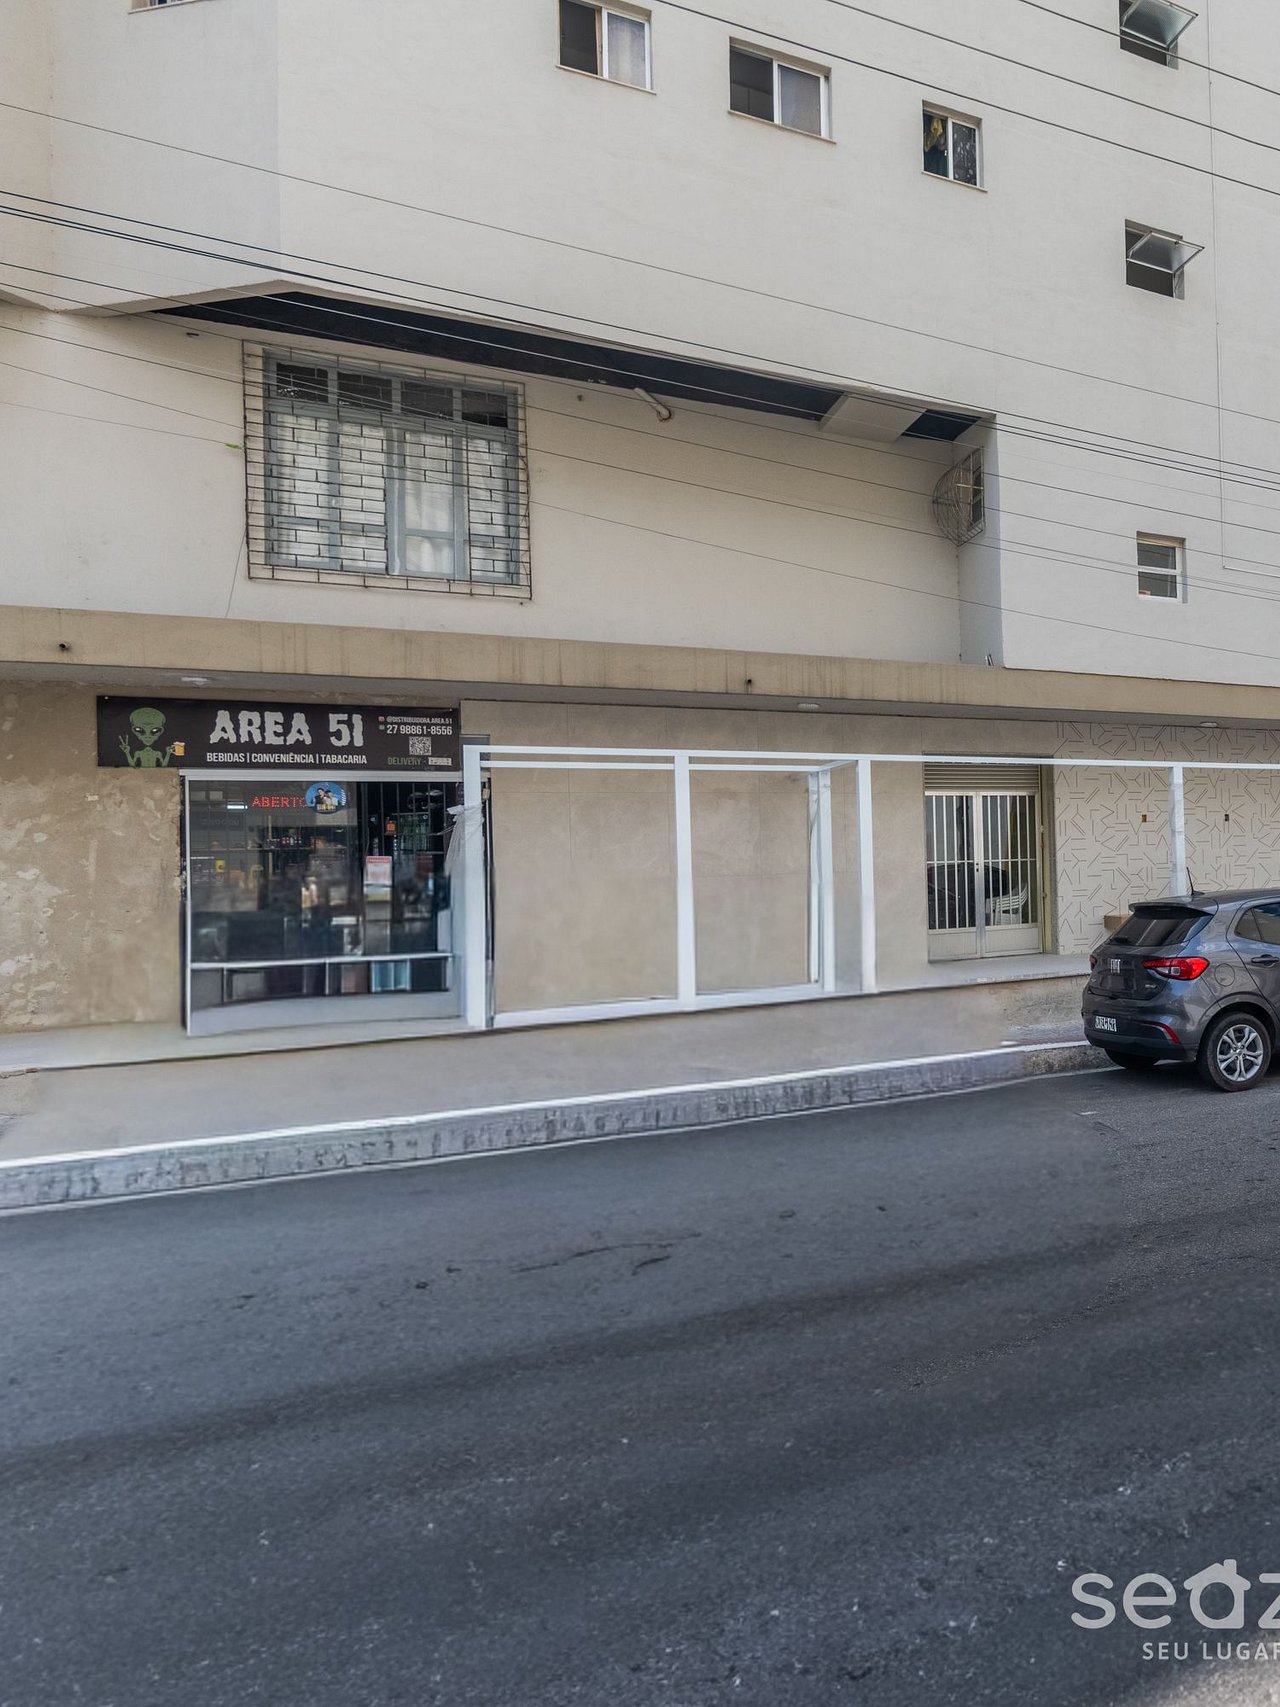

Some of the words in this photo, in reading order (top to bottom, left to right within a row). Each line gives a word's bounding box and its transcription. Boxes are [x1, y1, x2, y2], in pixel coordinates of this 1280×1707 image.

[209, 710, 312, 746] AREA
[328, 713, 364, 747] 51
[386, 724, 398, 734] 27
[400, 724, 453, 735] 98861-8556
[206, 752, 245, 763] BEBIDAS
[251, 751, 315, 764] CONVENIÊNCIA
[320, 753, 368, 765] TABACARIA
[387, 756, 421, 766] DELIVERY
